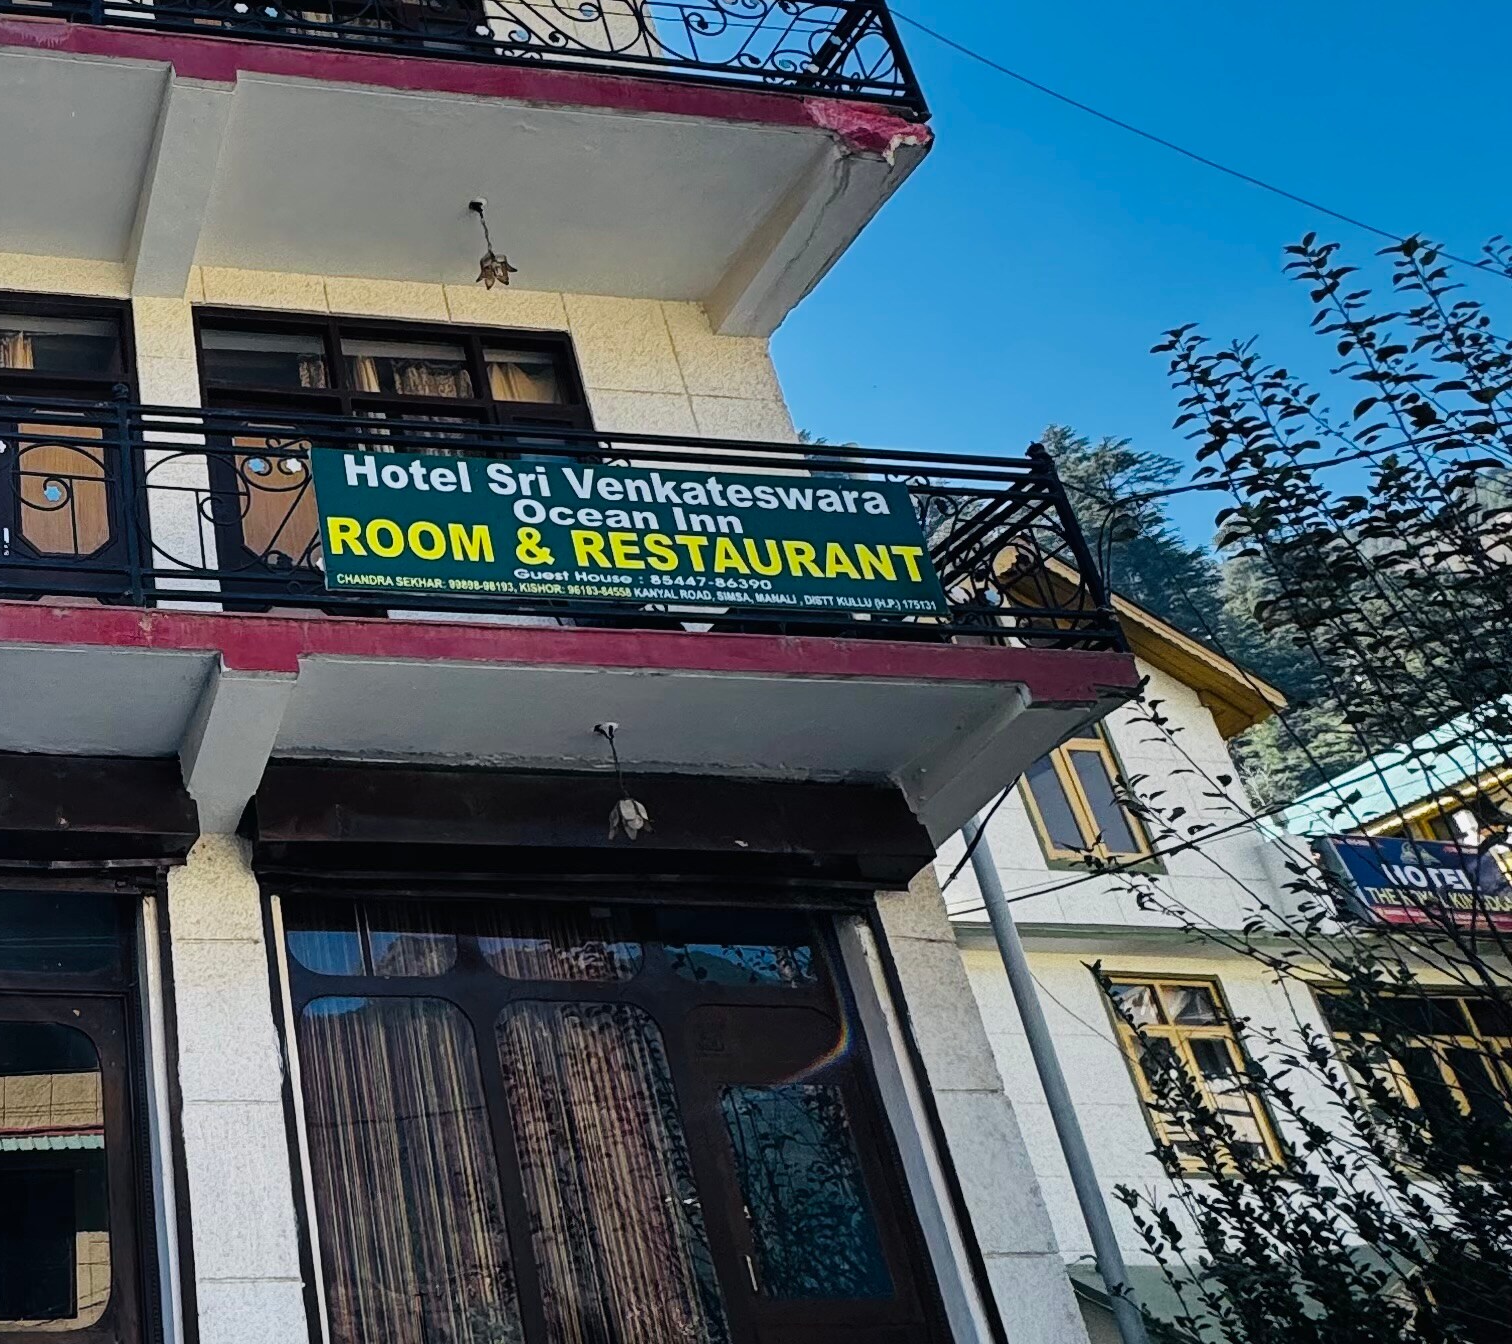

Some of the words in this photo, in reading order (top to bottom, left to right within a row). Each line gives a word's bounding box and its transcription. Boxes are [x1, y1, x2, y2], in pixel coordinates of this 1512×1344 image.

[343, 453, 473, 493] Hotel
[486, 462, 552, 498] Sri
[562, 466, 891, 515] Venkateswara
[513, 498, 660, 530] Ocean
[672, 506, 744, 534] Inn
[326, 516, 495, 563] ROOM
[515, 526, 556, 566] &
[570, 528, 924, 583] RESTAURANT
[336, 573, 394, 587] CHANDRA
[395, 576, 447, 590] SEKHAR:
[519, 582, 566, 595] KISHOR:
[633, 587, 679, 600] KANYAL
[679, 589, 716, 602] ROAD,
[716, 591, 754, 604] SIMSA,
[804, 594, 834, 606] DISTT
[836, 596, 873, 608] KULLU
[902, 599, 937, 611] 175131
[513, 568, 570, 582] Guest
[574, 570, 633, 585] House
[649, 574, 773, 591] 85447-86390
[1364, 886, 1403, 906] THE
